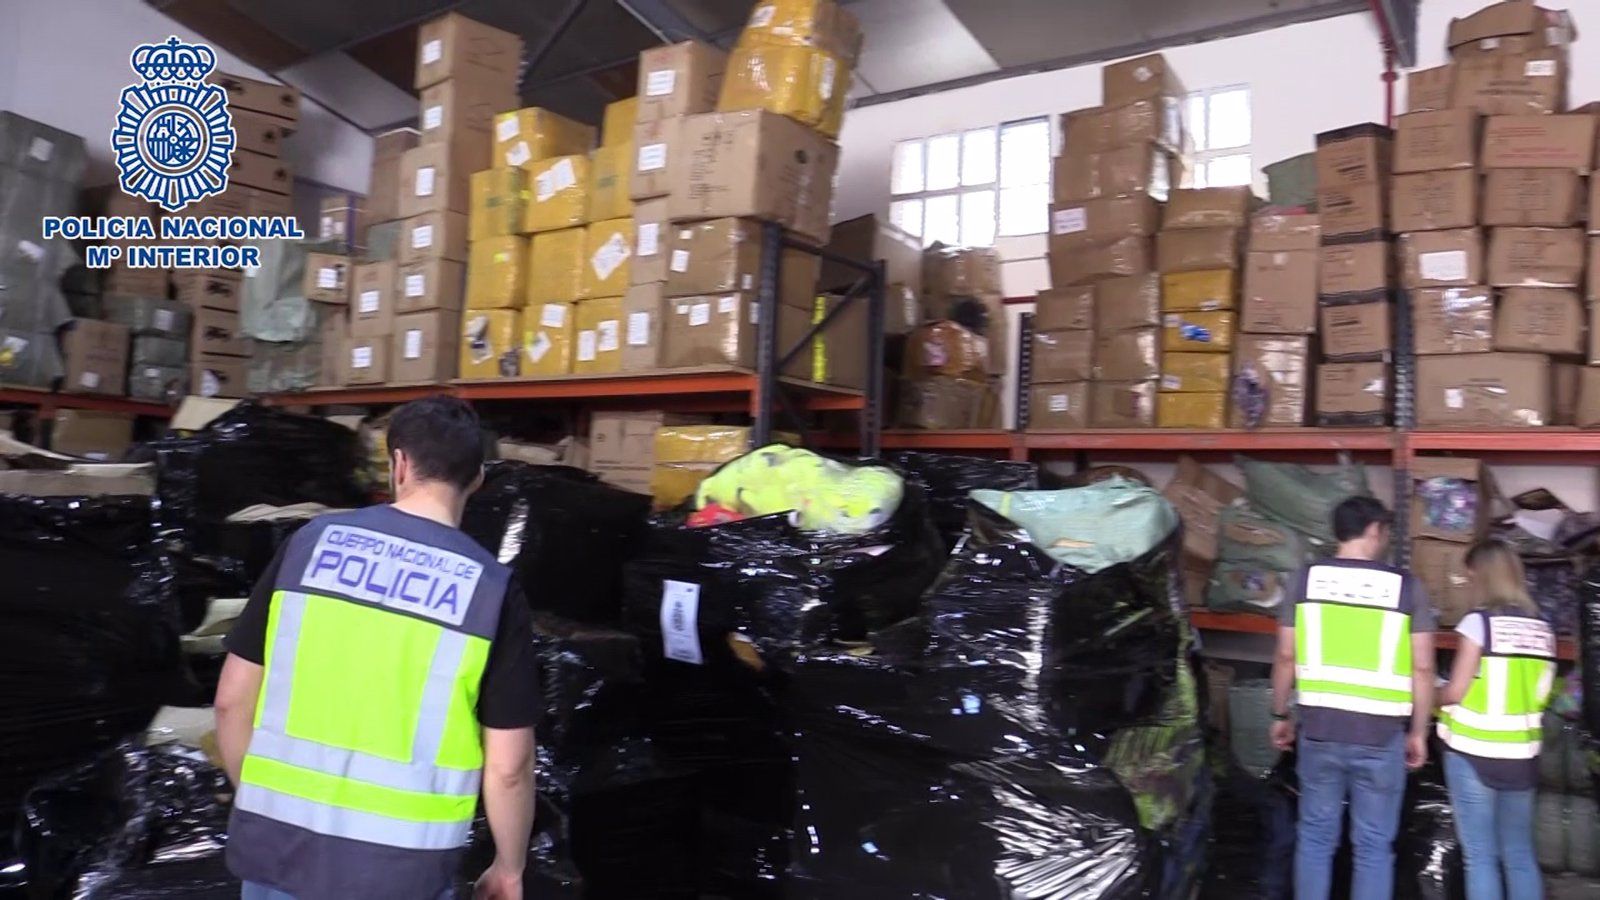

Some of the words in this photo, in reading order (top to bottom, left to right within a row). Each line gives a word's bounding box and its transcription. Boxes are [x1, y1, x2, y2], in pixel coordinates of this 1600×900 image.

[310, 550, 459, 615] POLICIA
[385, 543, 451, 573] NACIONAL
[452, 562, 478, 580] DE
